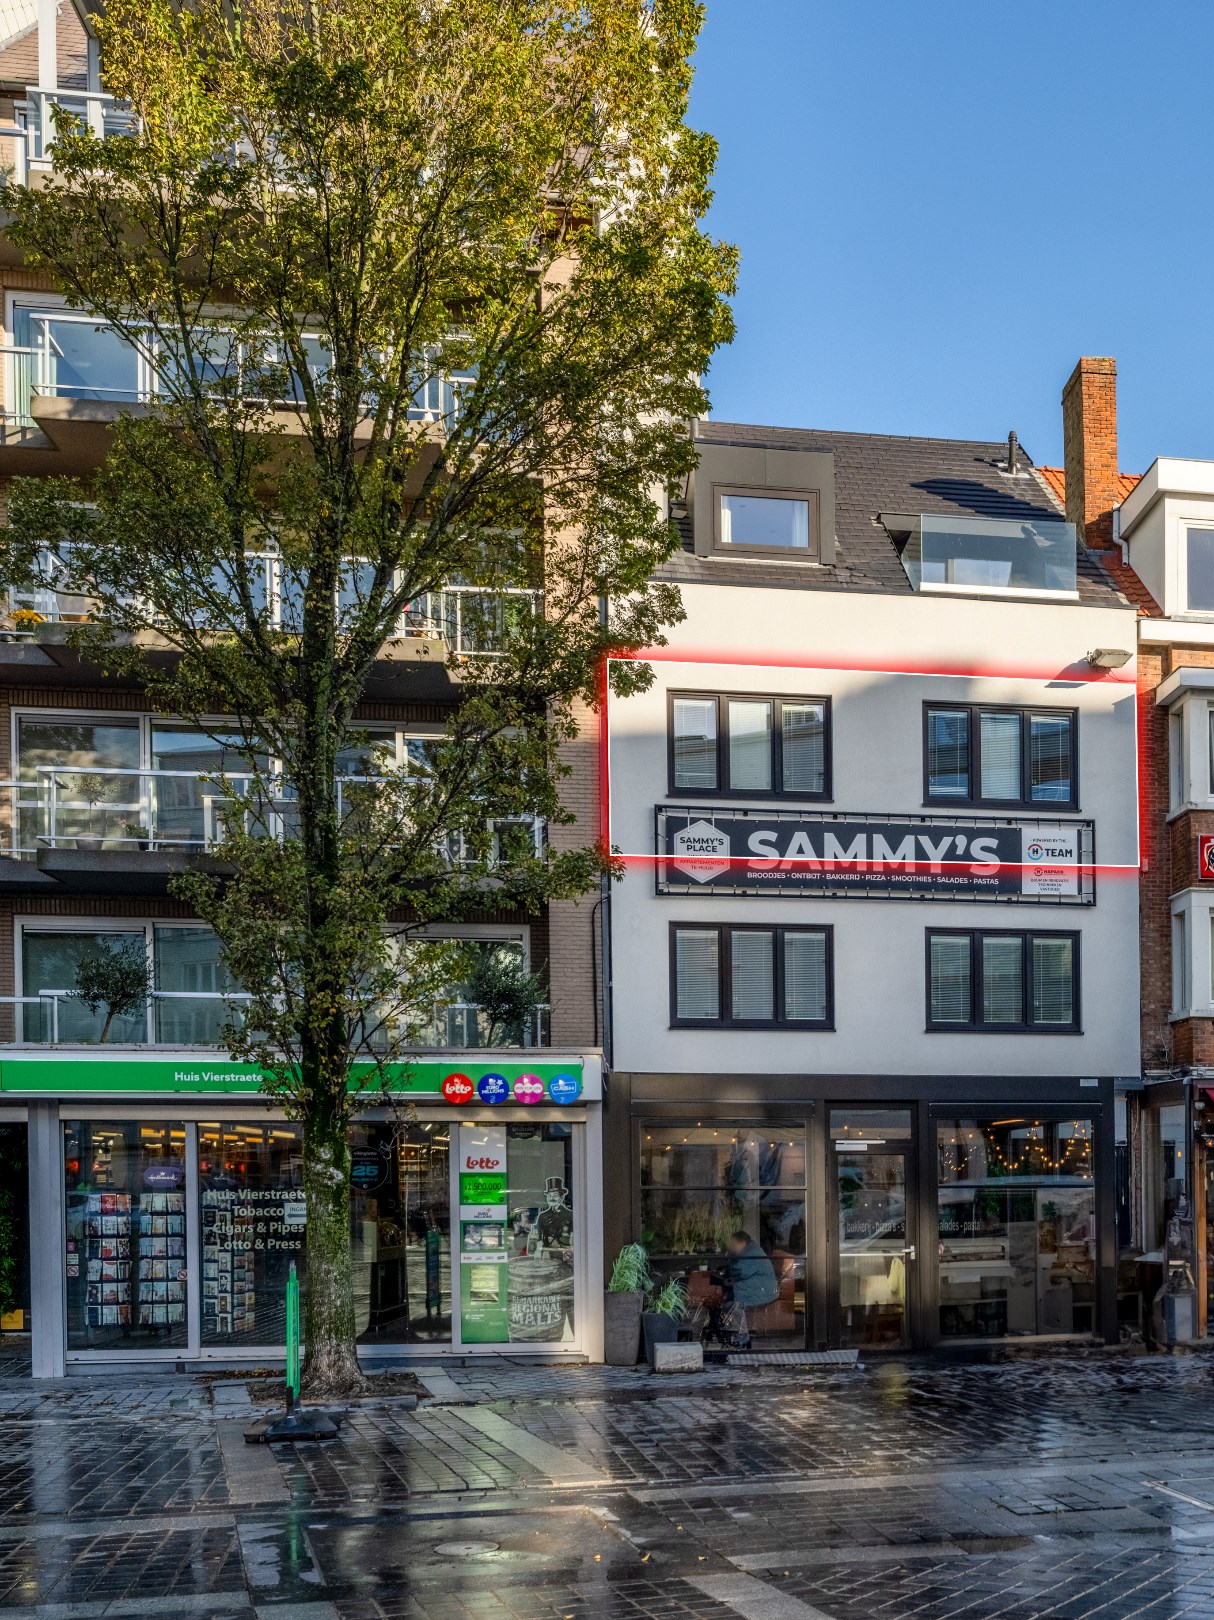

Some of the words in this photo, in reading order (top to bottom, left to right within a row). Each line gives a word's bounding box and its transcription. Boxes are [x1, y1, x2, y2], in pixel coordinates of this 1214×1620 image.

[680, 837, 724, 846] SAMMY'S
[686, 844, 718, 853] PLACE
[747, 830, 1001, 876] SAMMY'S
[1045, 848, 1073, 858] TEAM
[891, 875, 932, 883] SMOOTHIES
[937, 876, 968, 884] SALADES
[174, 1071, 200, 1082] Huis
[201, 1071, 264, 1082] Vierstraete
[445, 1083, 472, 1094] Lotto
[466, 1156, 500, 1170] Lotto
[351, 1165, 379, 1177] 25
[207, 1188, 236, 1200] Huis
[231, 1205, 284, 1217] Tobacco
[213, 1222, 254, 1236] Cigars
[256, 1222, 267, 1233] &
[269, 1221, 305, 1236] Pipes
[937, 1219, 960, 1231] alades
[218, 1239, 252, 1250] Lotto
[254, 1238, 265, 1250] &
[267, 1238, 302, 1250] Press
[511, 1302, 562, 1313] REGIONAL
[512, 1311, 562, 1326] MALTS
